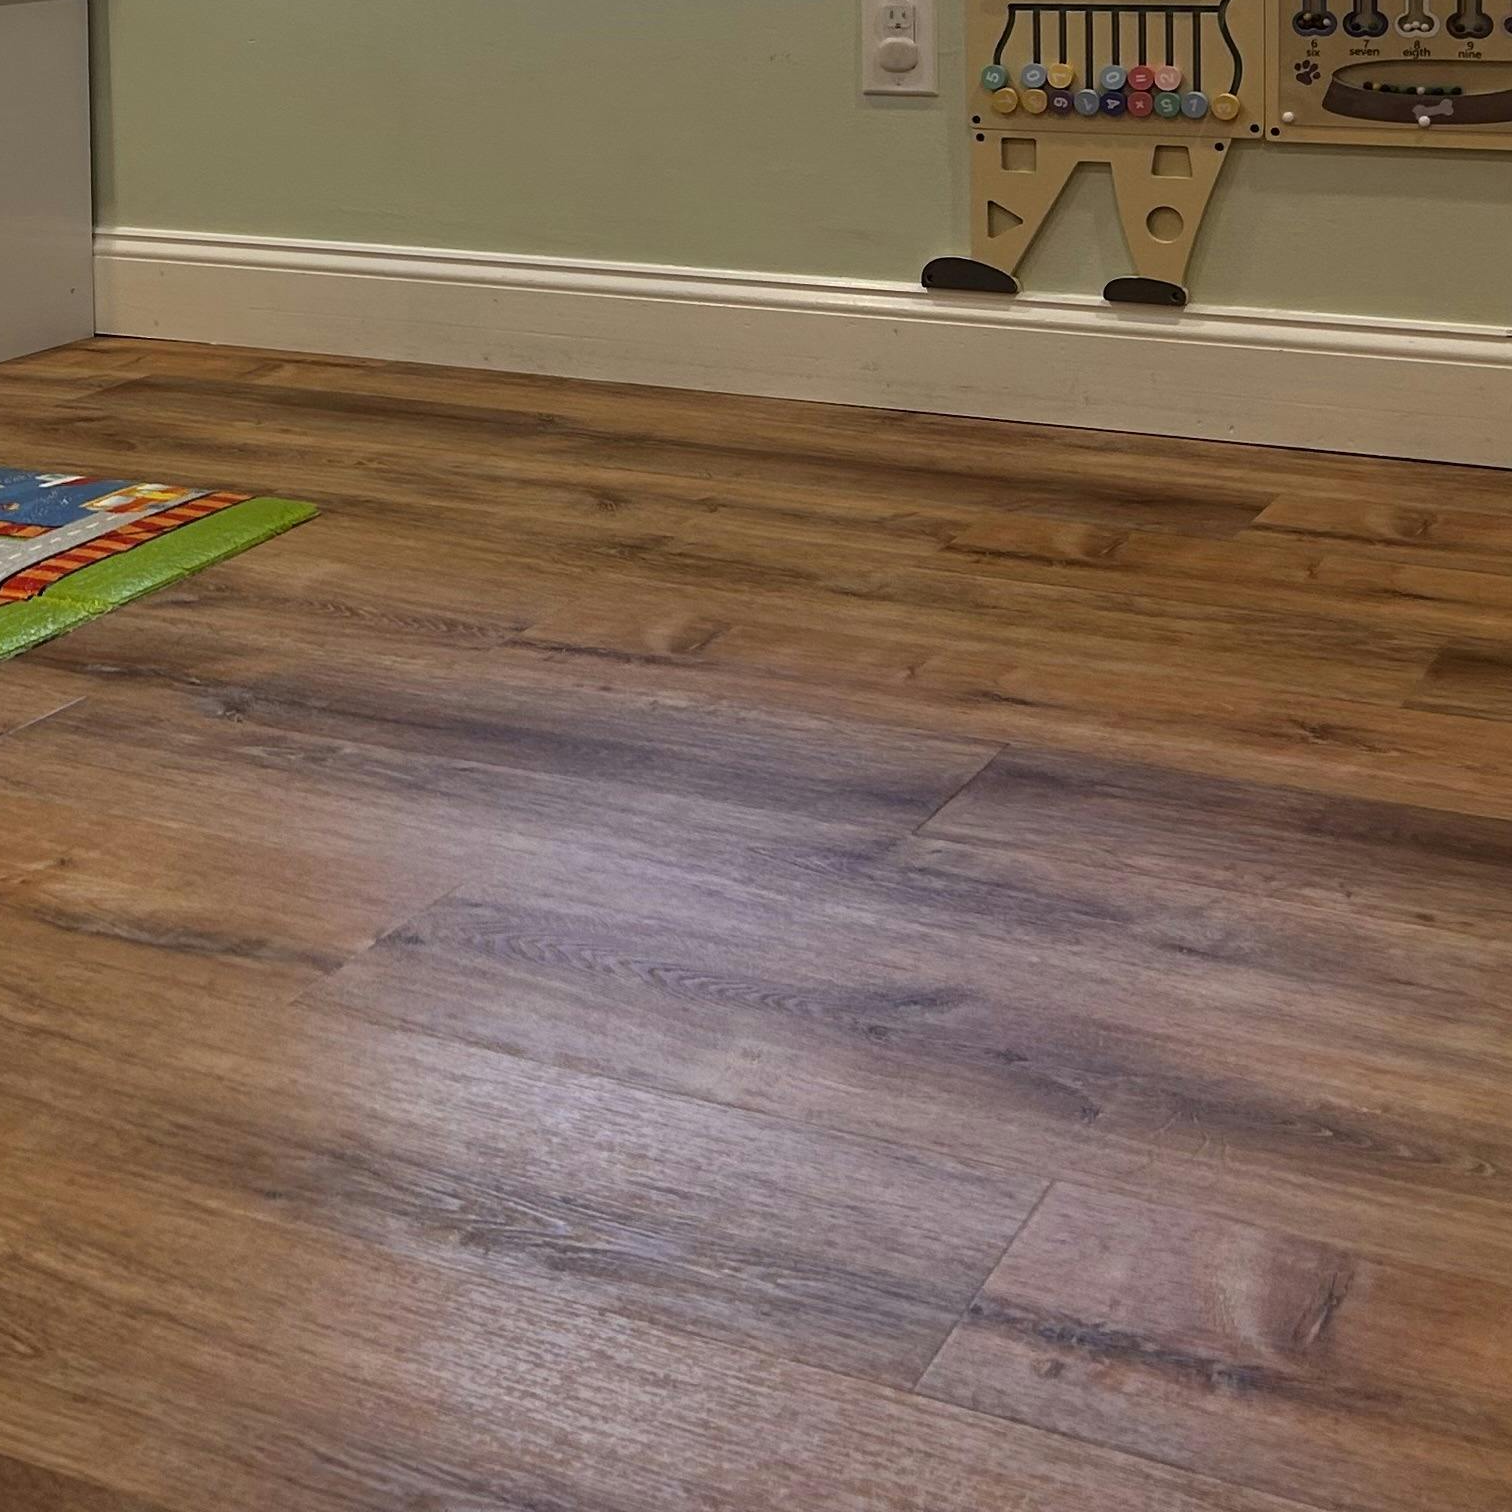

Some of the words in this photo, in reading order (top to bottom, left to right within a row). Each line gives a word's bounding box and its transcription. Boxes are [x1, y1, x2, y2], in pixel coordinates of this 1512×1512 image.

[1311, 40, 1318, 48] 6
[1362, 40, 1370, 48] 7
[1413, 40, 1420, 48] 8
[1467, 41, 1474, 50] 9
[1306, 48, 1320, 57] six
[1349, 48, 1380, 56] seven
[1458, 50, 1482, 59] nine
